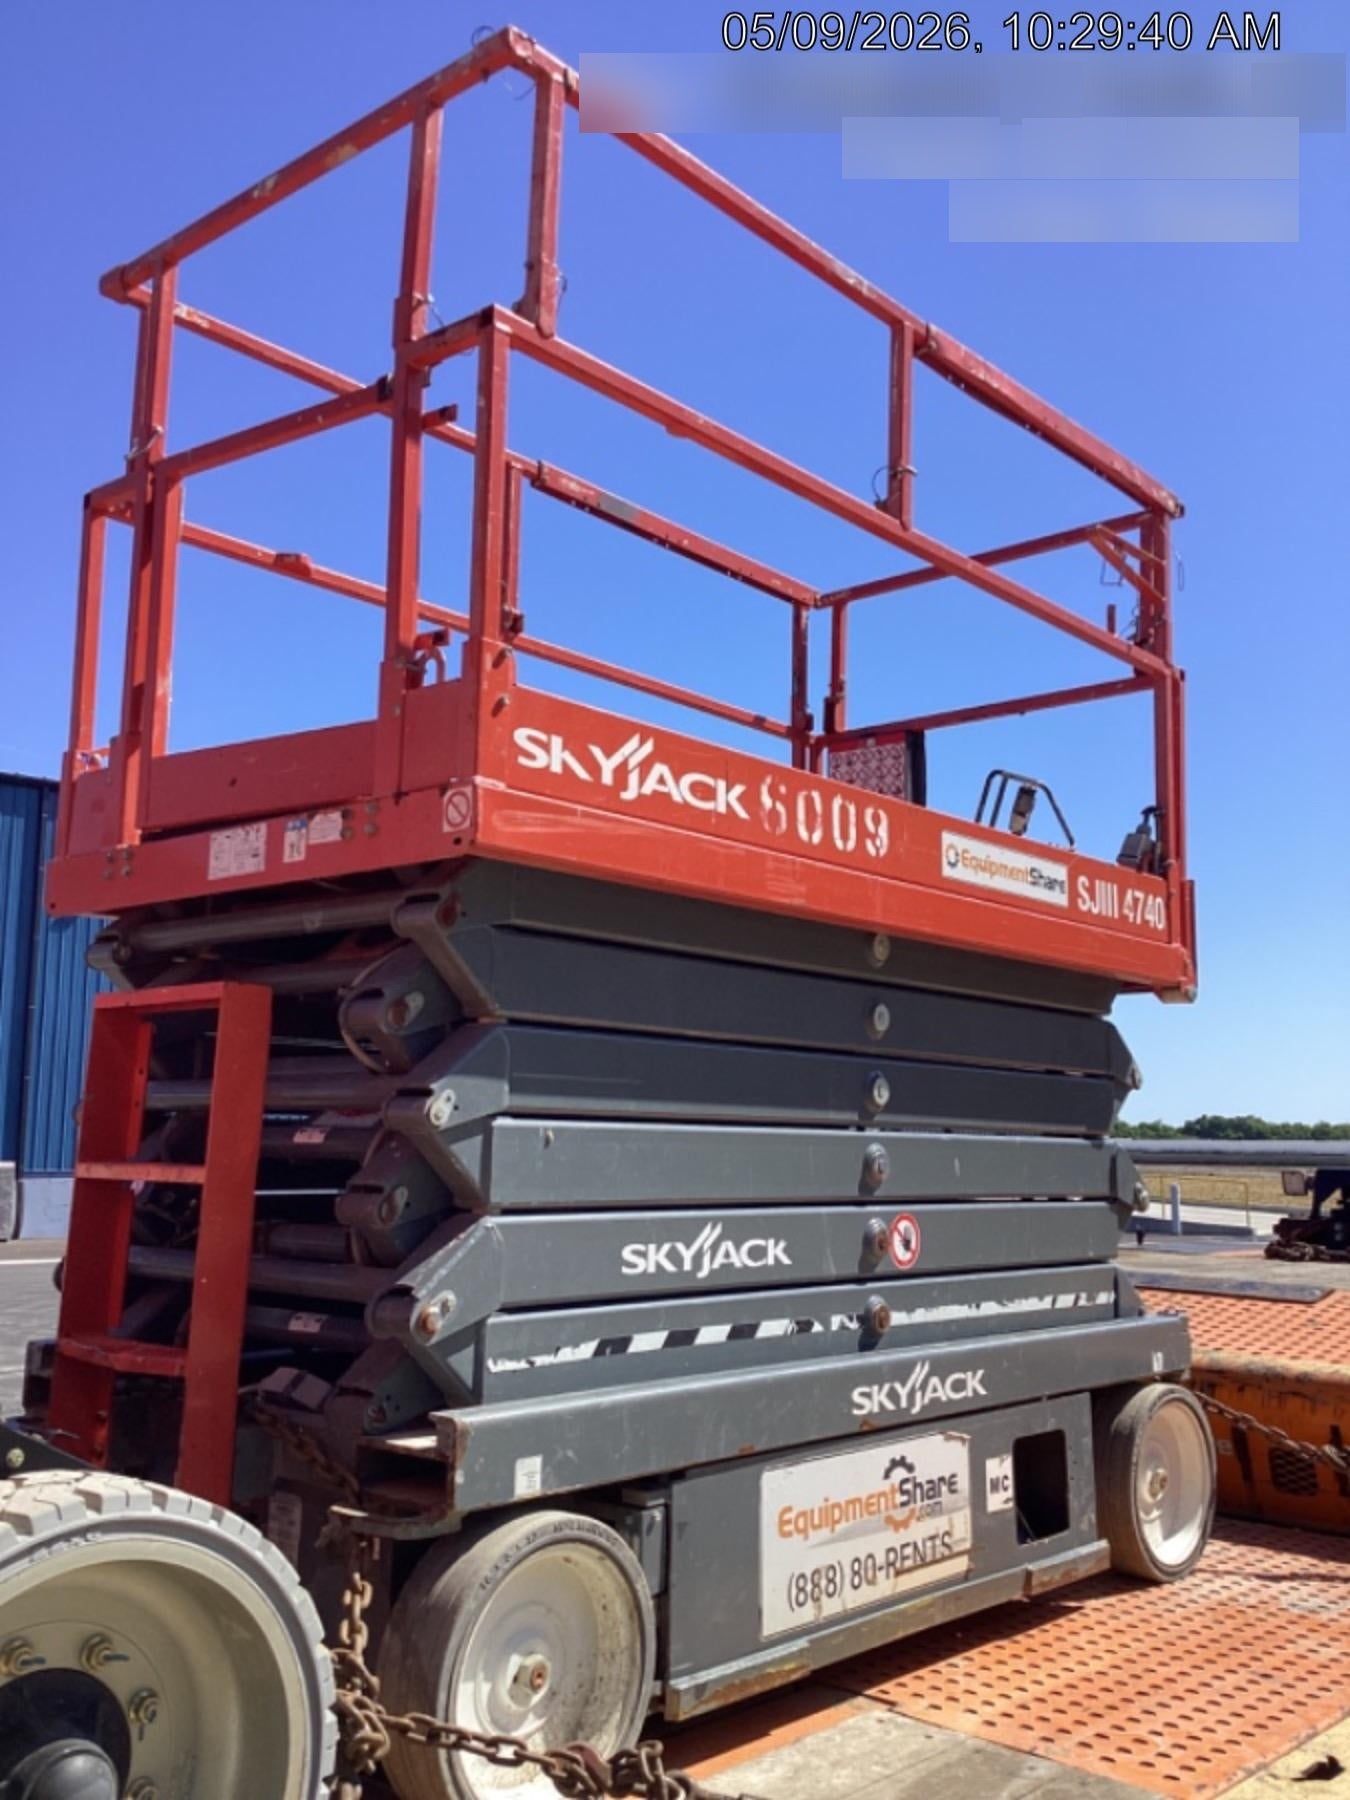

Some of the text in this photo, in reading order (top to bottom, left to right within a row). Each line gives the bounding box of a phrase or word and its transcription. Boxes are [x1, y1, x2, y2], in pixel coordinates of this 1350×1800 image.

[512, 727, 749, 820] SKYJACK
[960, 850, 1066, 894] EquipmentShare
[1077, 875, 1166, 930] SJIII 4740
[621, 1221, 792, 1279] SKYJACK
[851, 1360, 988, 1415] SKYJACK
[776, 1472, 958, 1541] EquipmentShare
[787, 1530, 954, 1613] (888) 80-RENTS
